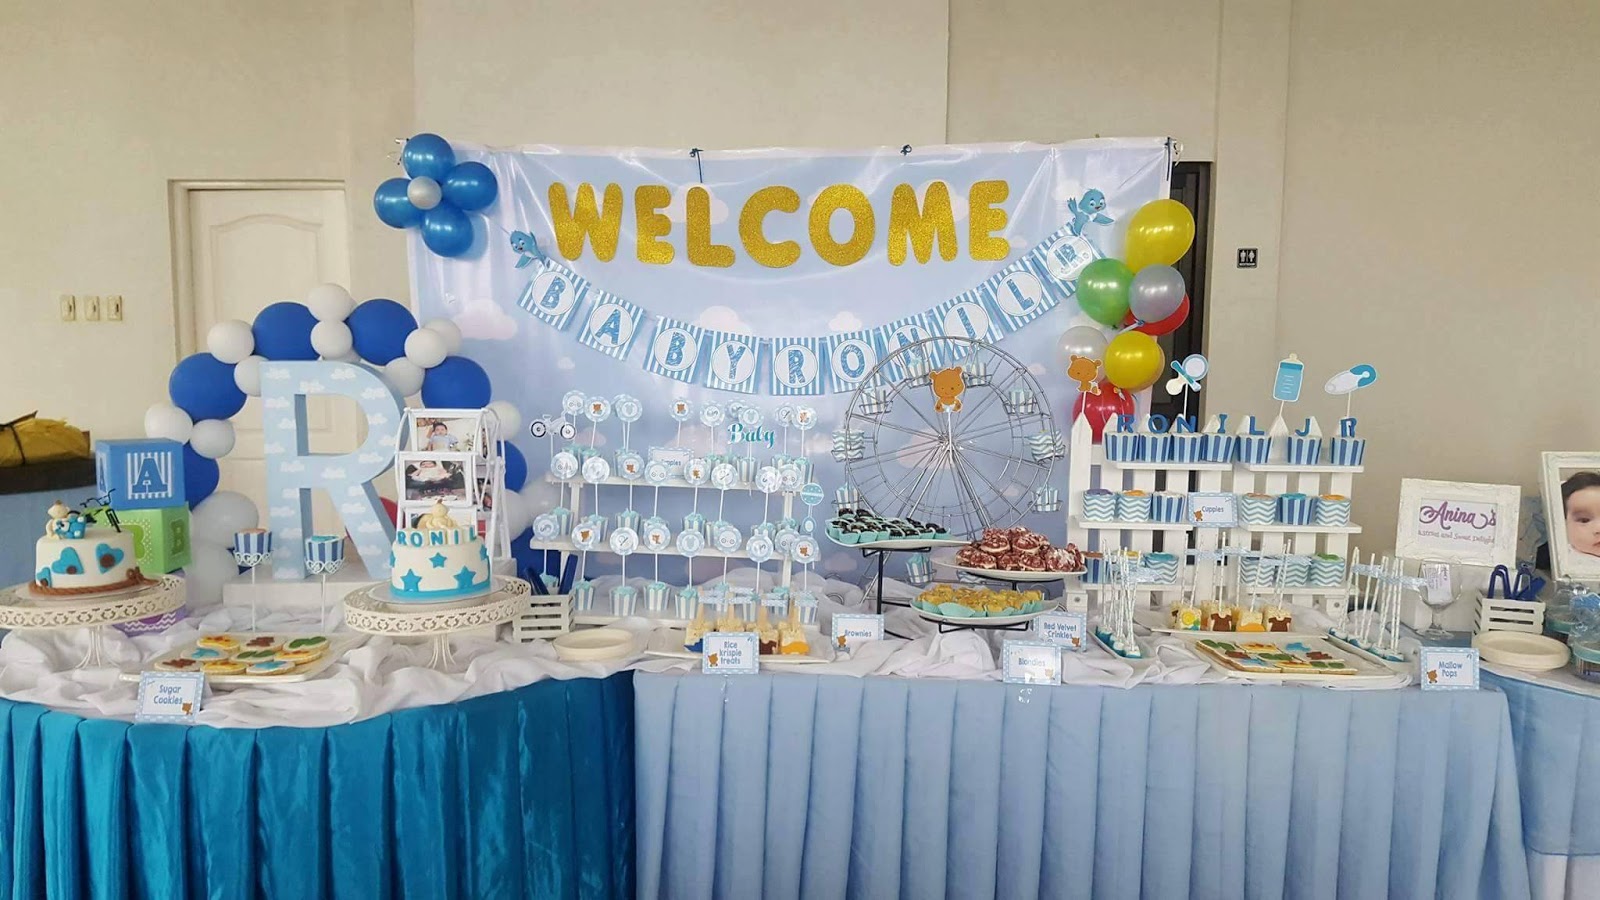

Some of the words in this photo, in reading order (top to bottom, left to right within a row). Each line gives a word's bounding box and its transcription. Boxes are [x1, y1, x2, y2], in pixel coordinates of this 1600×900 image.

[547, 179, 1011, 268] WELCOME
[540, 275, 746, 380] BABY
[1116, 413, 1265, 436] RONIL
[727, 423, 775, 449] Baby
[131, 457, 169, 494] A
[259, 360, 408, 581] R
[397, 526, 477, 548] RONIL
[1043, 622, 1056, 630] Red
[1057, 623, 1077, 632] Velvet
[1047, 631, 1073, 639] Crinkles
[723, 641, 738, 649] Rice
[1438, 661, 1463, 669] Mallow
[1441, 669, 1458, 678] Pops
[159, 684, 182, 695] Sugar
[153, 695, 183, 705] Cookies
